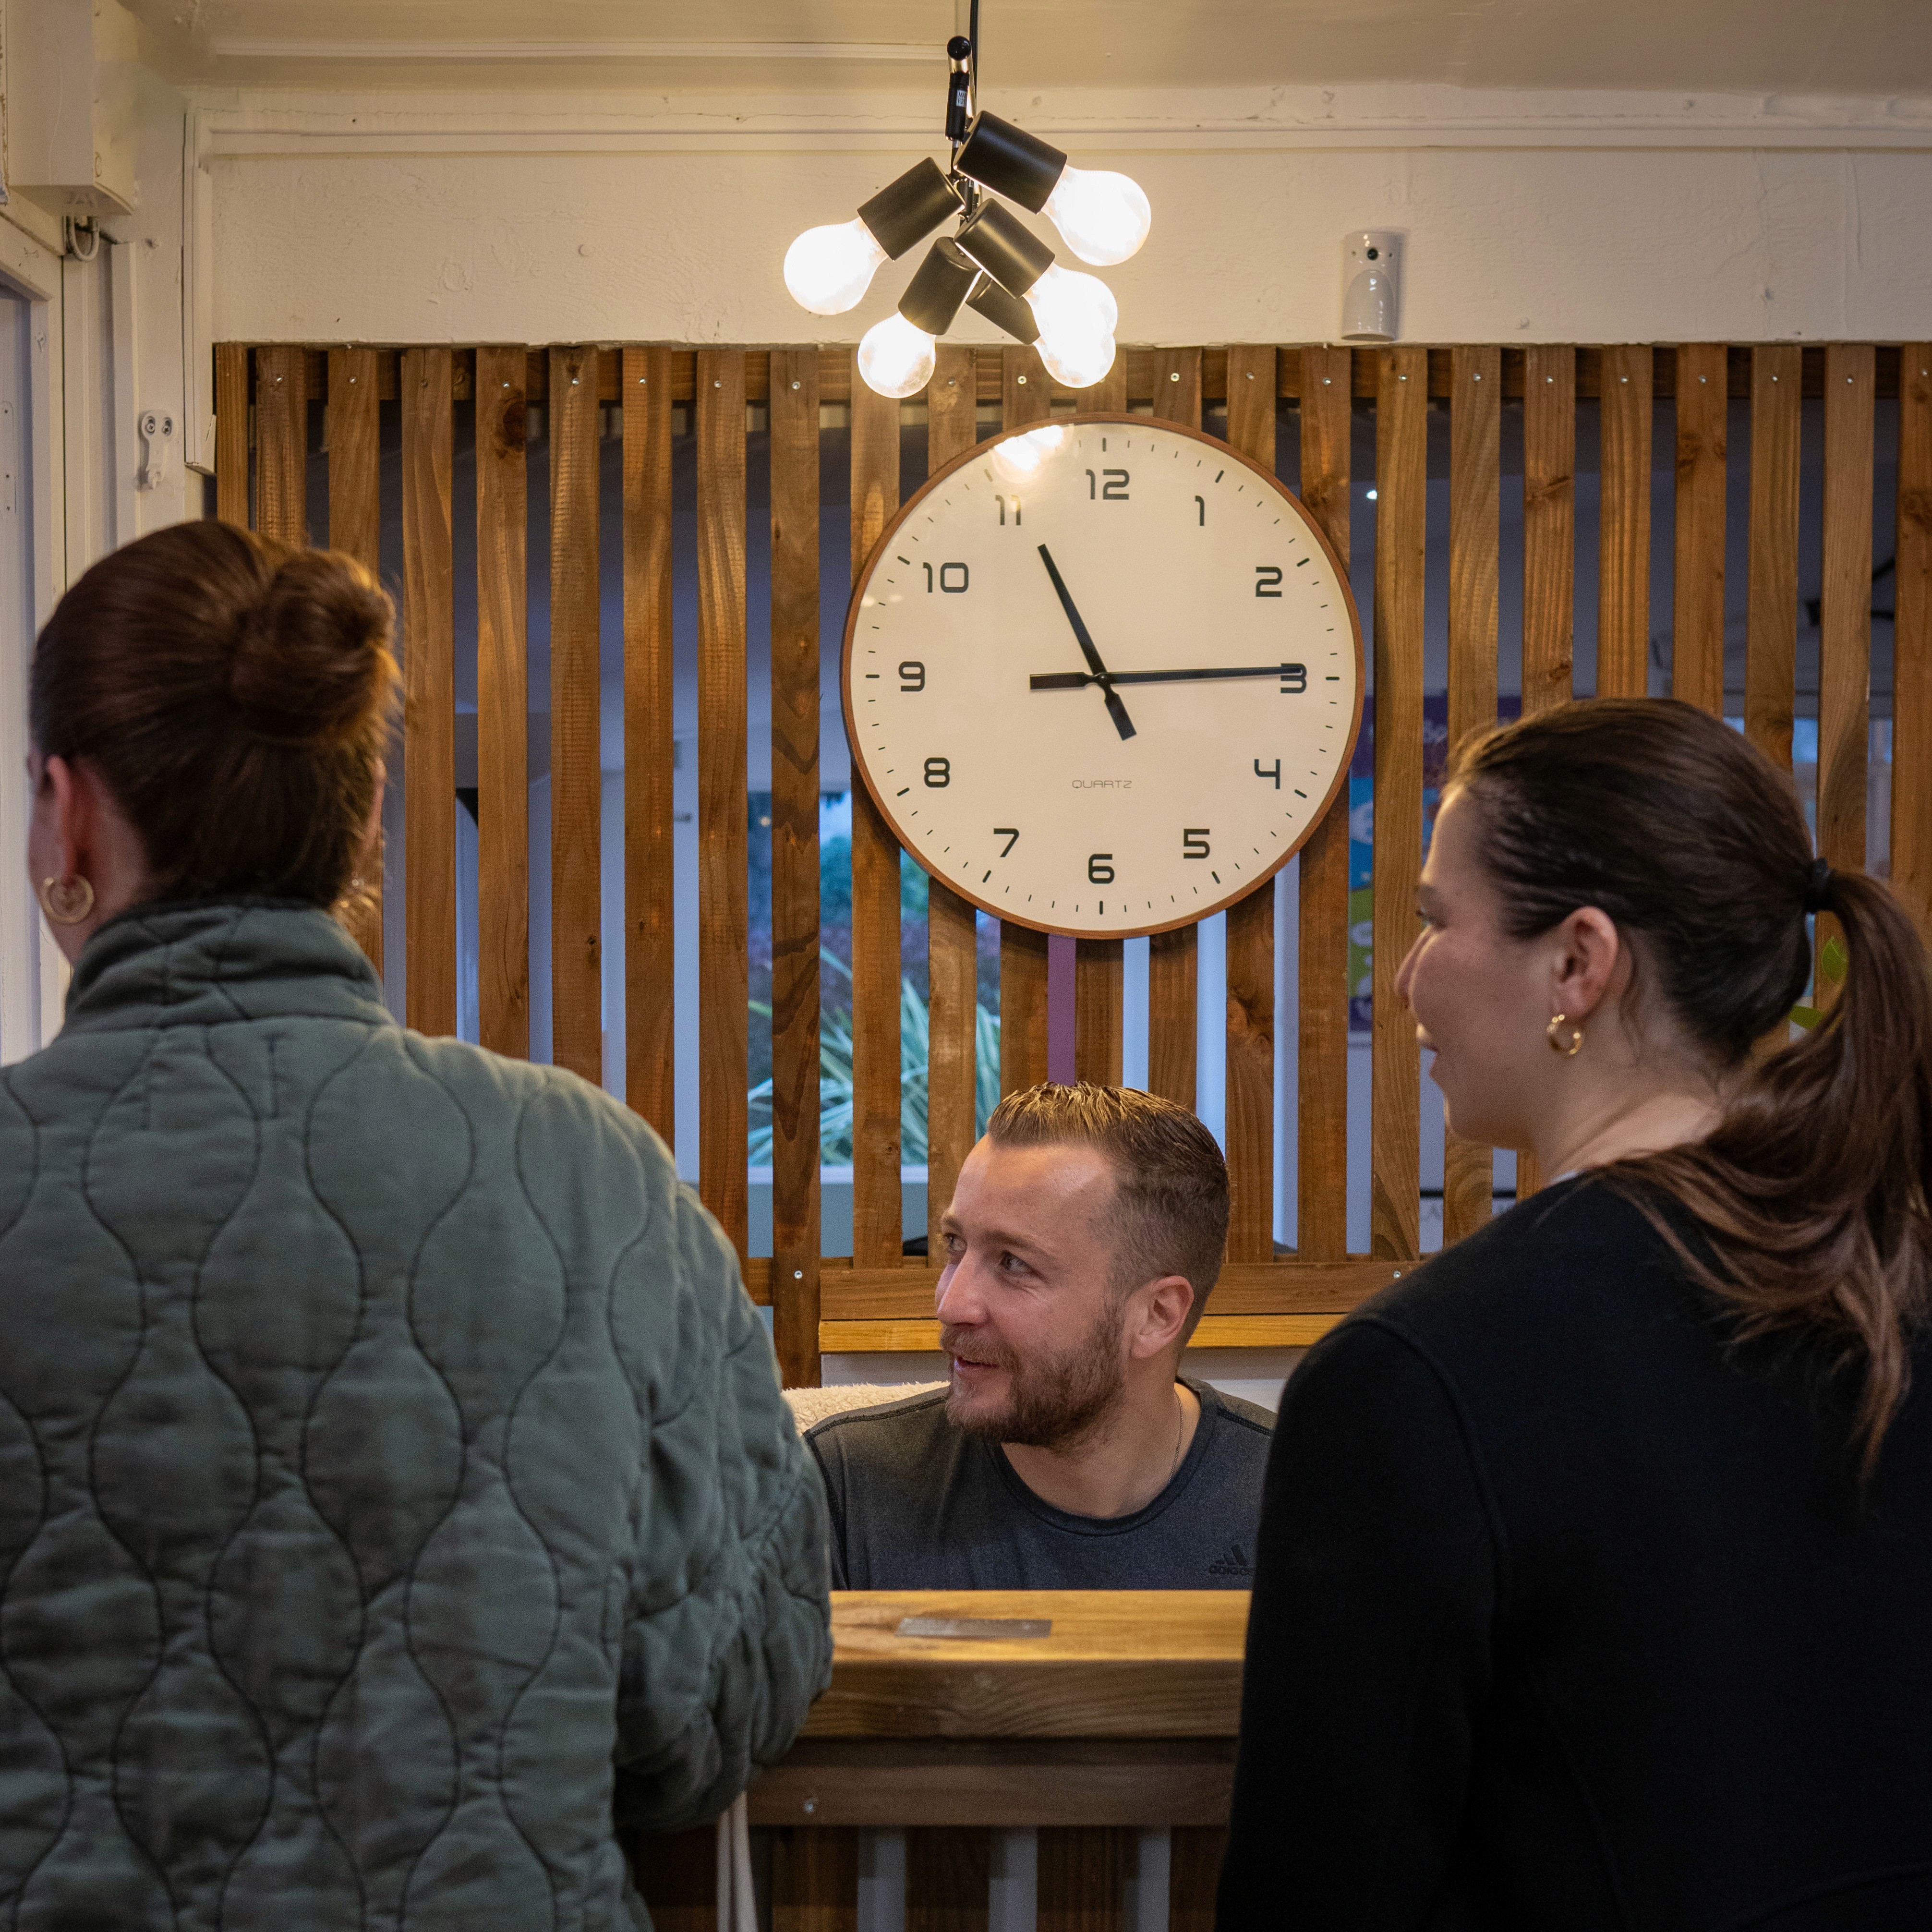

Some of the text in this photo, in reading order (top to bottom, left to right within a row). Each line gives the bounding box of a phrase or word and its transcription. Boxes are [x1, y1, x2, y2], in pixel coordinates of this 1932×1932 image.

[1086, 469, 1129, 500] 12
[996, 495, 1021, 526] 11
[1195, 495, 1204, 526] 1
[923, 562, 969, 593] 10
[1256, 567, 1282, 597] 2
[898, 662, 925, 692] 9
[1280, 663, 1306, 693] 3
[924, 758, 950, 788] 8
[1072, 780, 1132, 789] QUARTZ
[1254, 759, 1280, 789] 4
[993, 828, 1019, 857] 7
[1183, 829, 1210, 859] 5
[1088, 854, 1114, 884] 6
